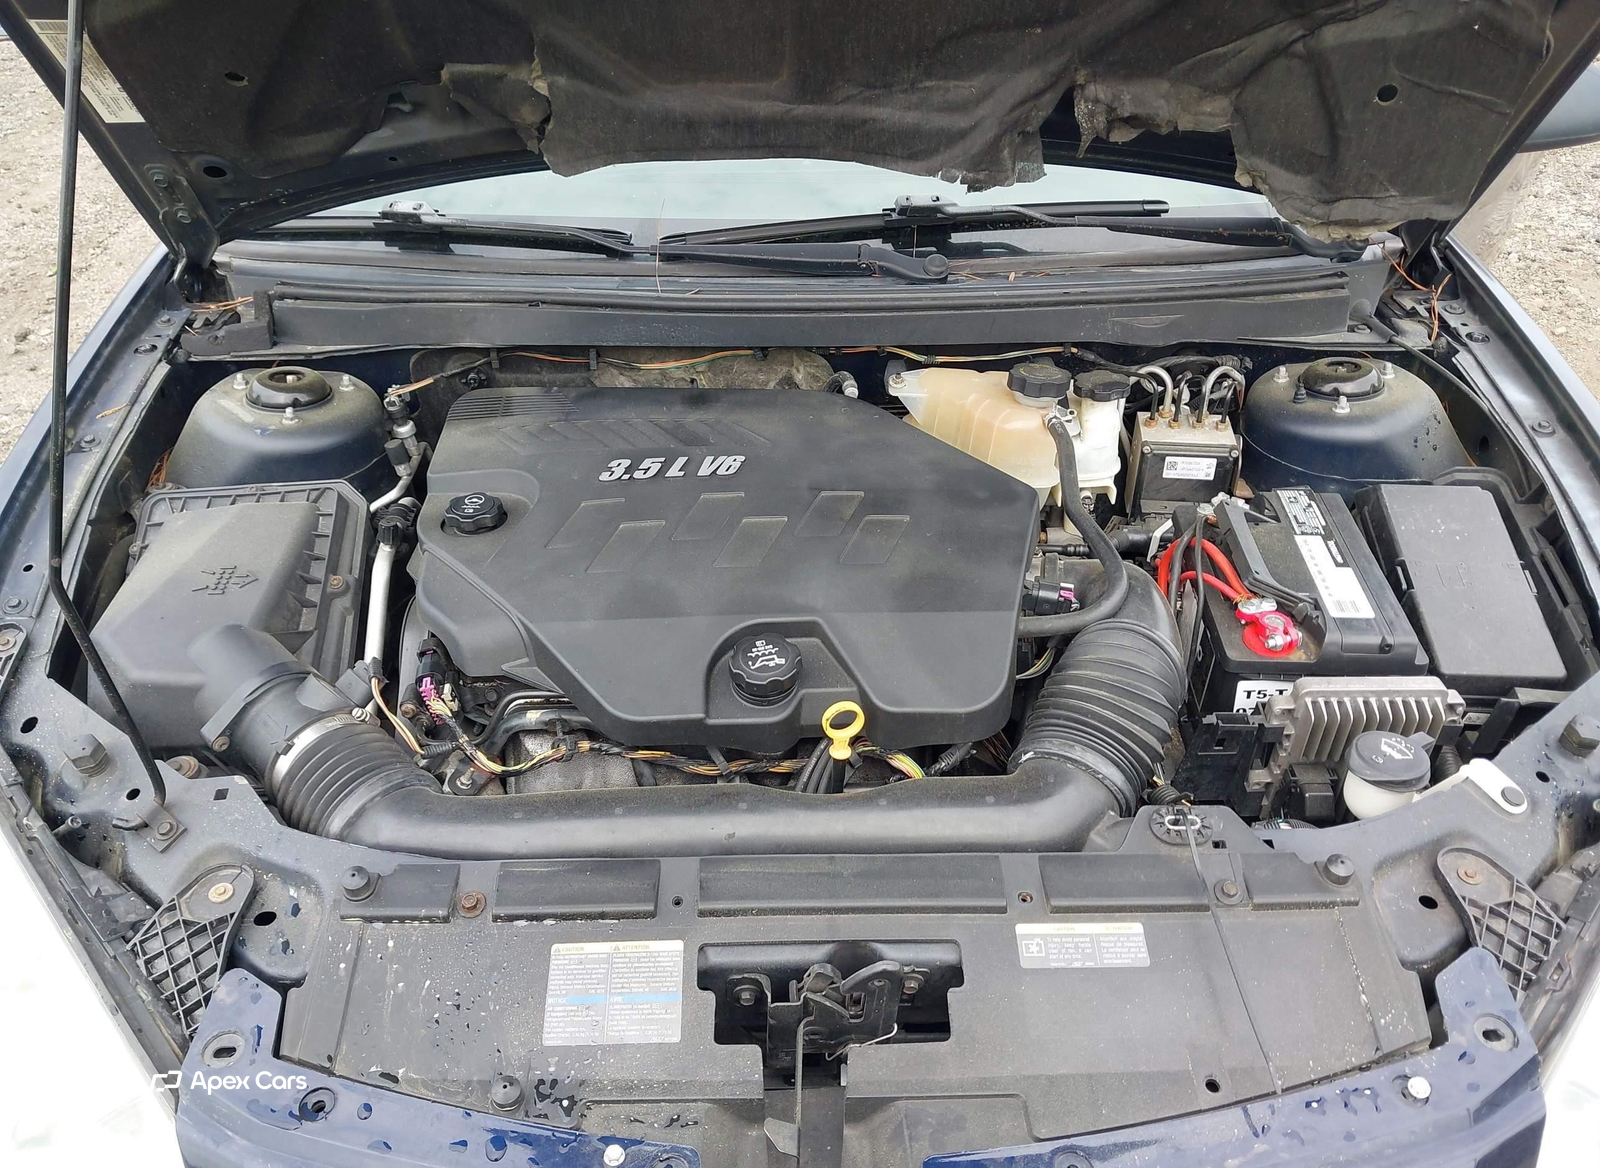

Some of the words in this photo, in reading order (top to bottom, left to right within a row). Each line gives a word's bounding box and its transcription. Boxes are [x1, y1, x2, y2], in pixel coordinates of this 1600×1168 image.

[599, 457, 666, 482] 3.5
[665, 456, 689, 478] L
[697, 455, 746, 477] V6
